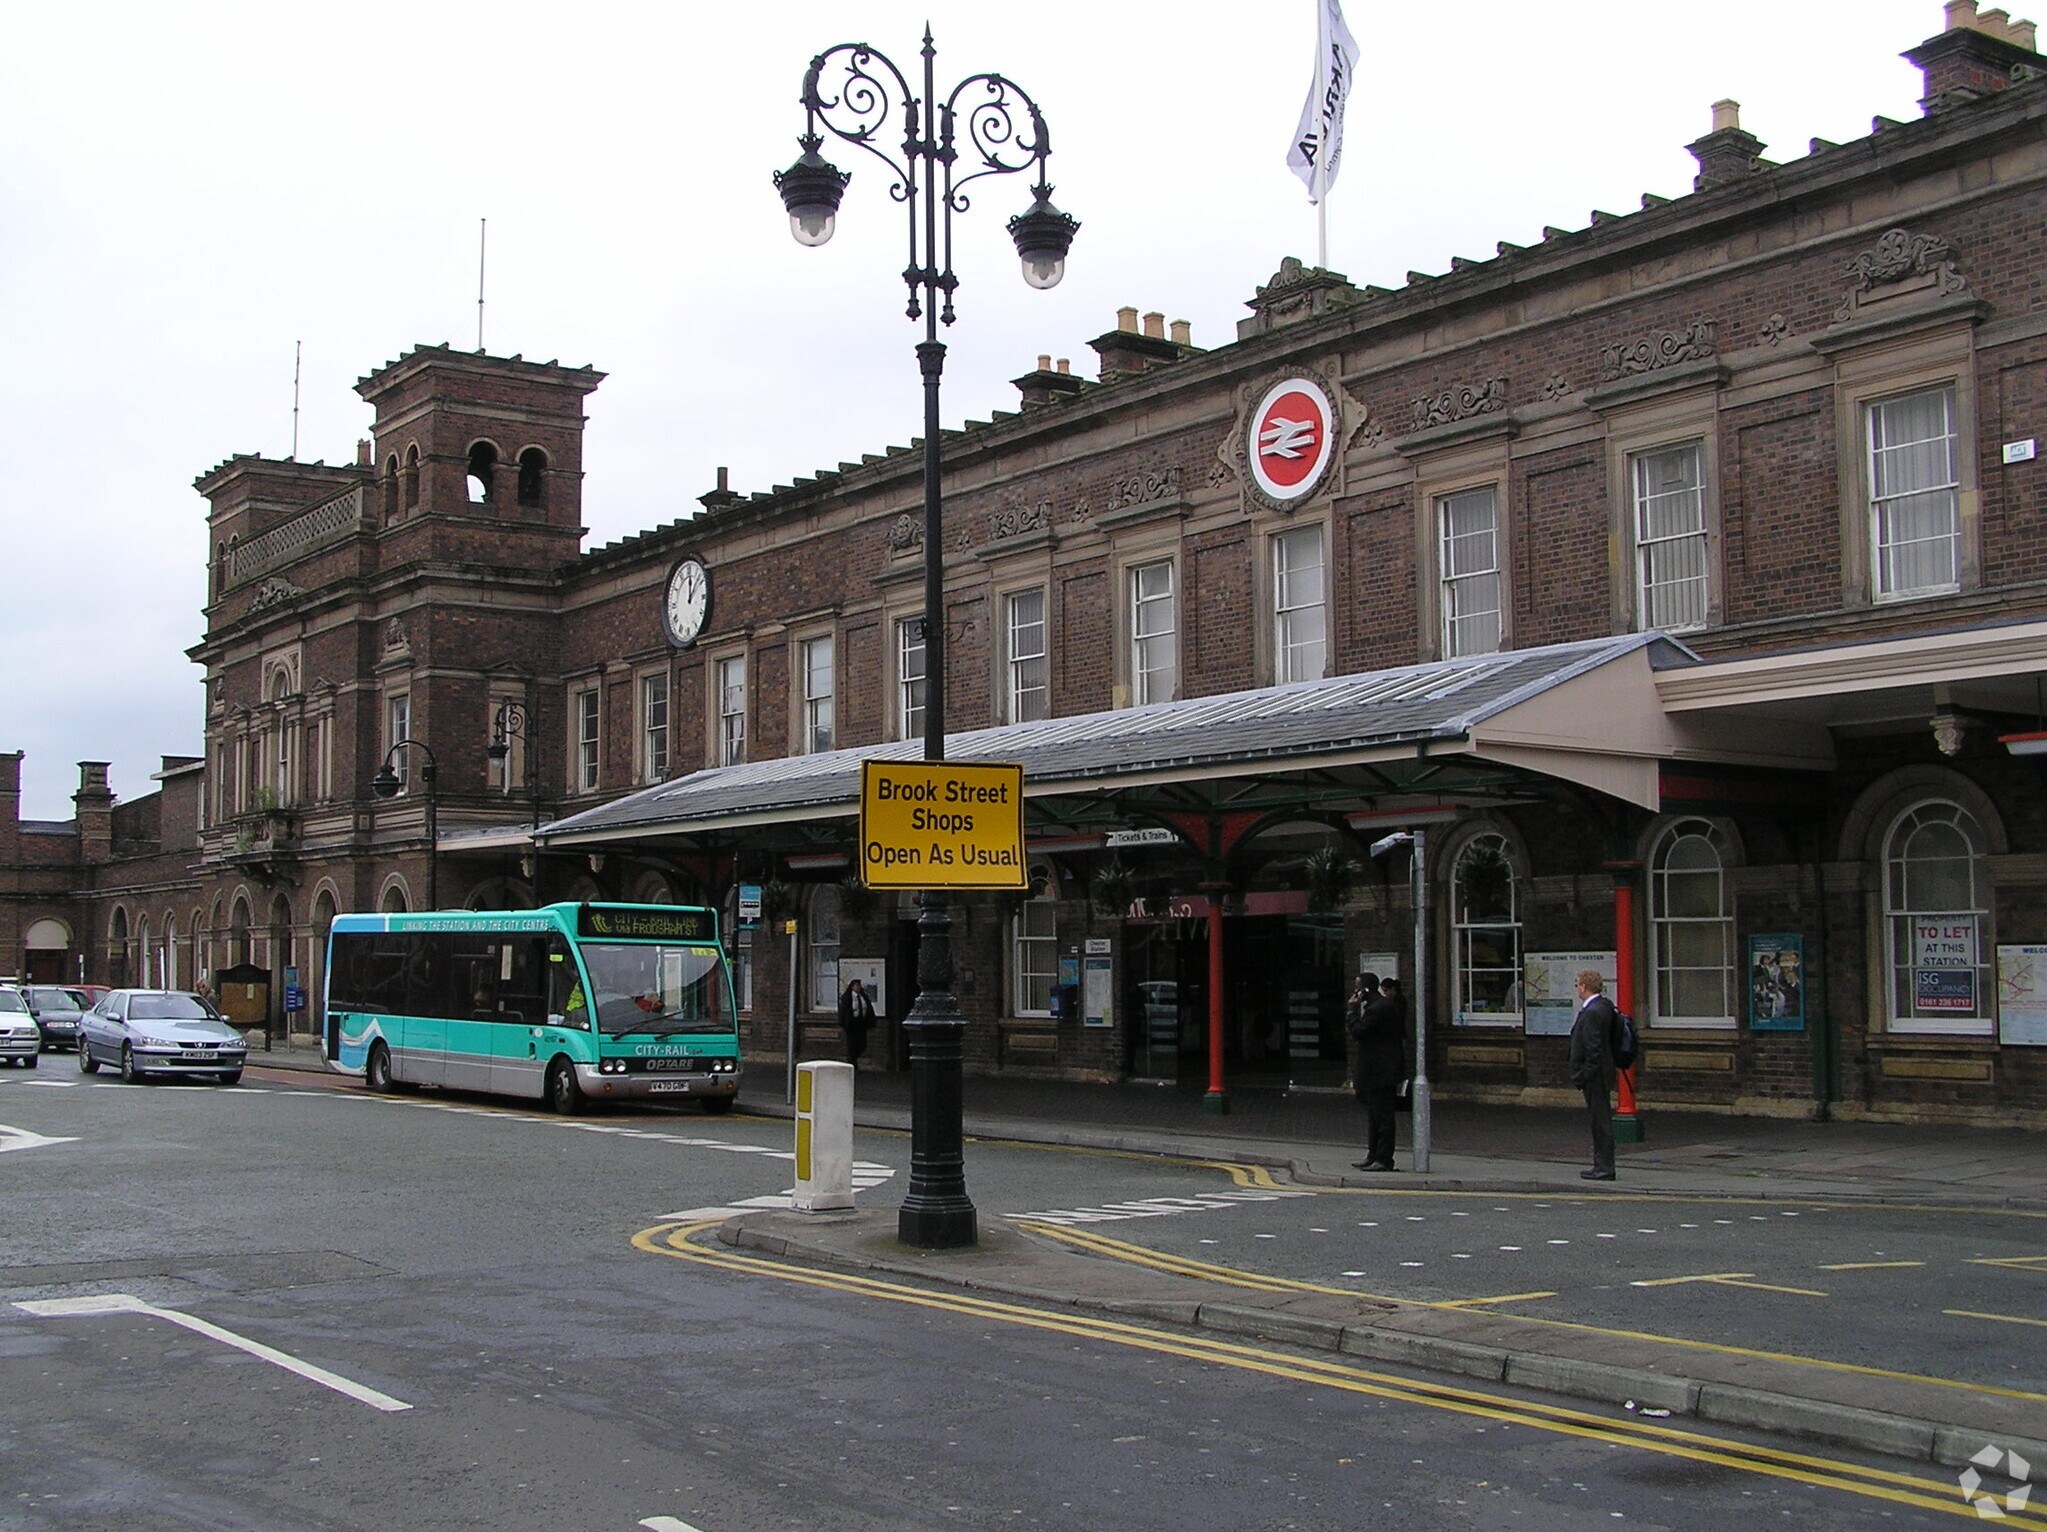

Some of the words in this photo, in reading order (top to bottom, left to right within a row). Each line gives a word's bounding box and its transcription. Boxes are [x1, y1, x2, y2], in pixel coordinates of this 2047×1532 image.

[878, 778, 938, 802] Brook
[944, 780, 1008, 804] Street
[911, 807, 974, 835] Shops
[867, 841, 921, 868] Open
[929, 843, 954, 865] As
[960, 843, 1019, 866] Usual
[614, 913, 639, 924] CITY
[428, 920, 442, 931] THE
[442, 920, 470, 931] STATION
[471, 920, 488, 931] AND
[489, 920, 502, 931] THE
[503, 920, 520, 931] CITY
[521, 919, 549, 931] CENTRE
[1918, 926, 1938, 938] TO
[1943, 926, 1971, 938] LET
[1925, 943, 1939, 953] AT
[1940, 943, 1965, 953] THIS
[1923, 957, 1967, 966] STATION
[1919, 973, 1939, 985] ISG
[635, 1045, 689, 1056] CITY-RAIL
[646, 1059, 694, 1071] OPTARE
